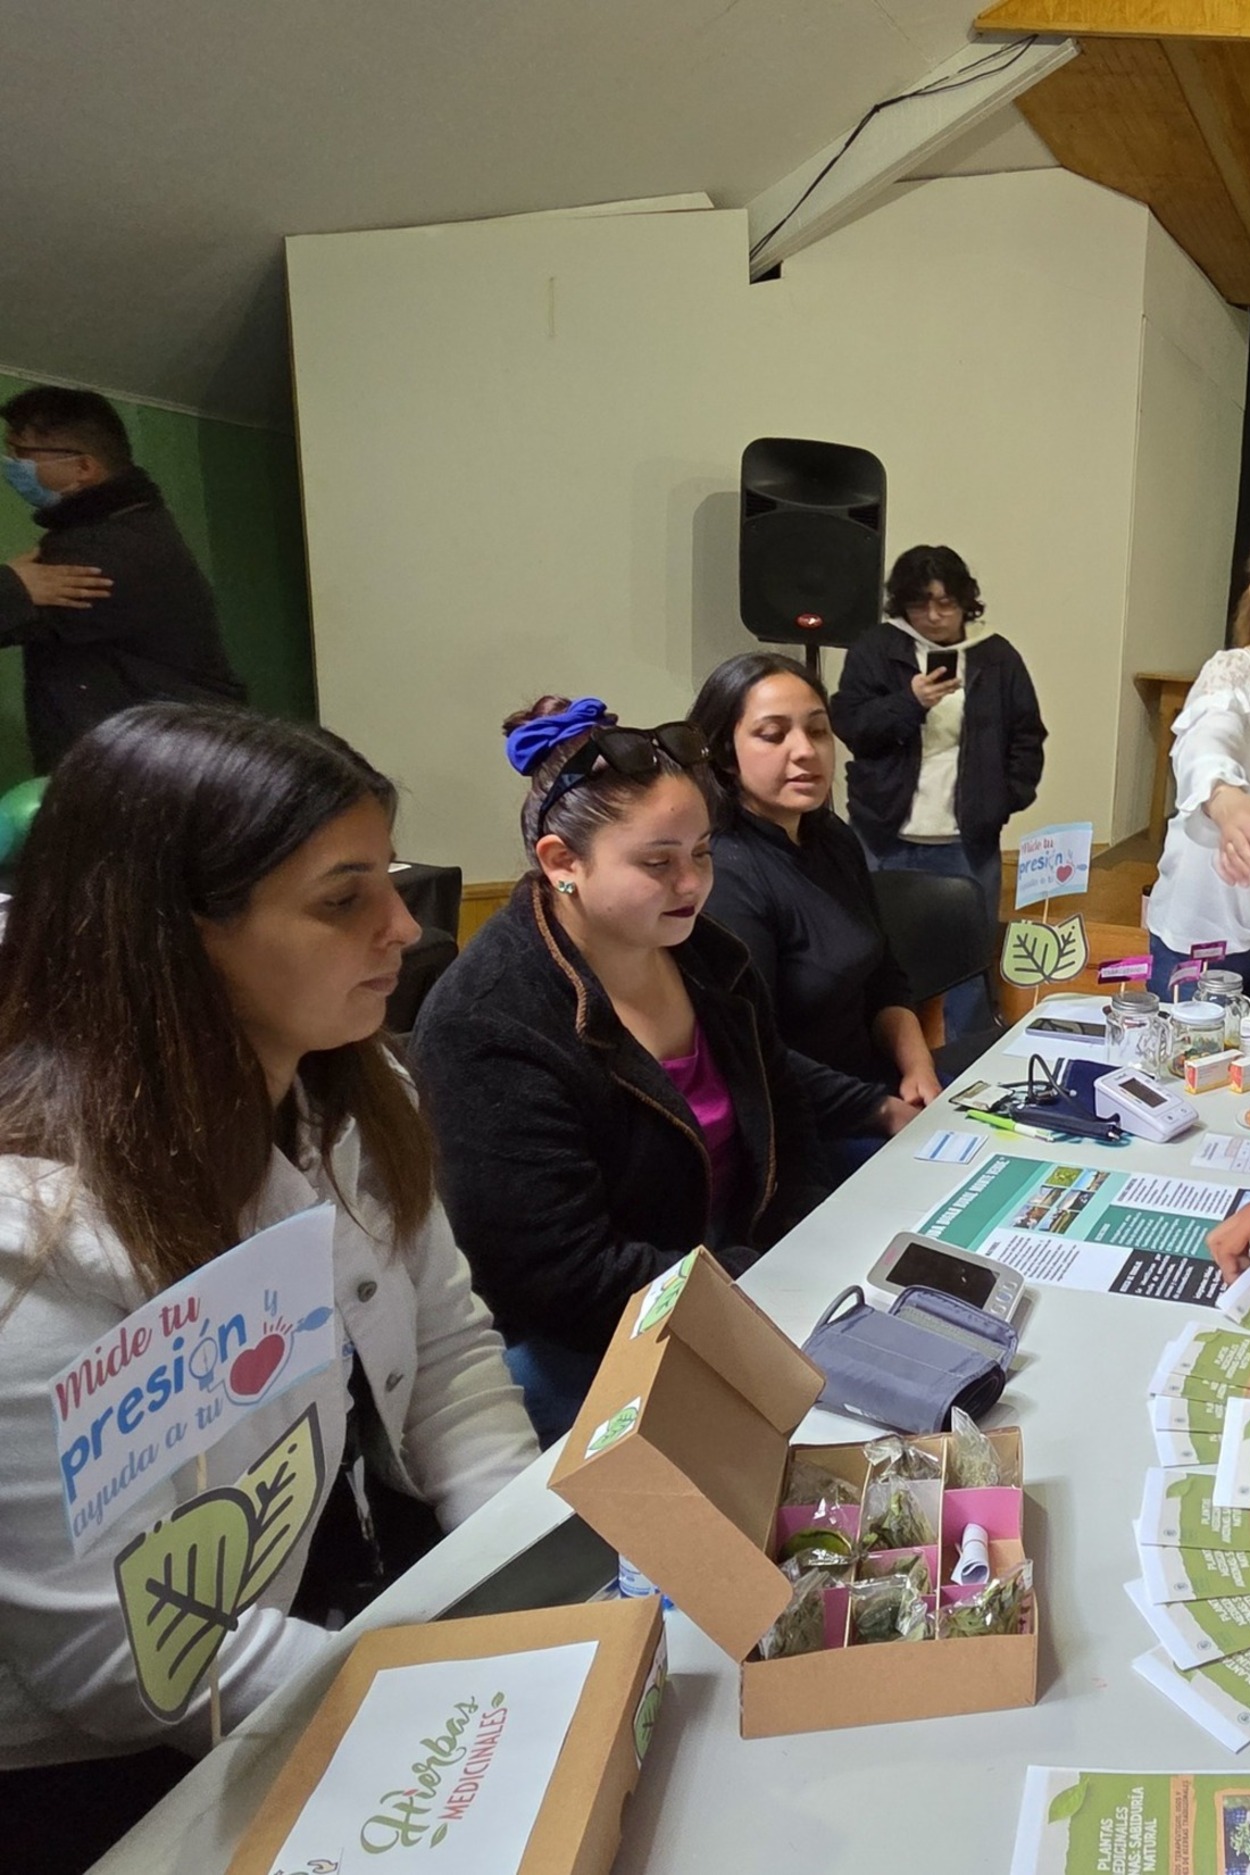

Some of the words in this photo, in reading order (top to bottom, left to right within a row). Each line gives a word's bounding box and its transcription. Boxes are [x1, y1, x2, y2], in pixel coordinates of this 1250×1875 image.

[264, 1289, 279, 1315] y
[55, 1326, 153, 1422] Mide
[160, 1297, 201, 1337] tu
[60, 1313, 248, 1504] presión
[73, 1445, 158, 1538] ayuda
[165, 1421, 187, 1448] a
[196, 1397, 224, 1431] tu
[1207, 1599, 1231, 1622] PLANT
[360, 1696, 479, 1854] Hierbas
[438, 1707, 509, 1821] MEDICINALES
[1097, 1818, 1113, 1871] PLANTAS
[1112, 1806, 1129, 1875] EDICINALES
[1127, 1786, 1144, 1848] SABIDURÍA
[1143, 1818, 1157, 1872] NATURAL
